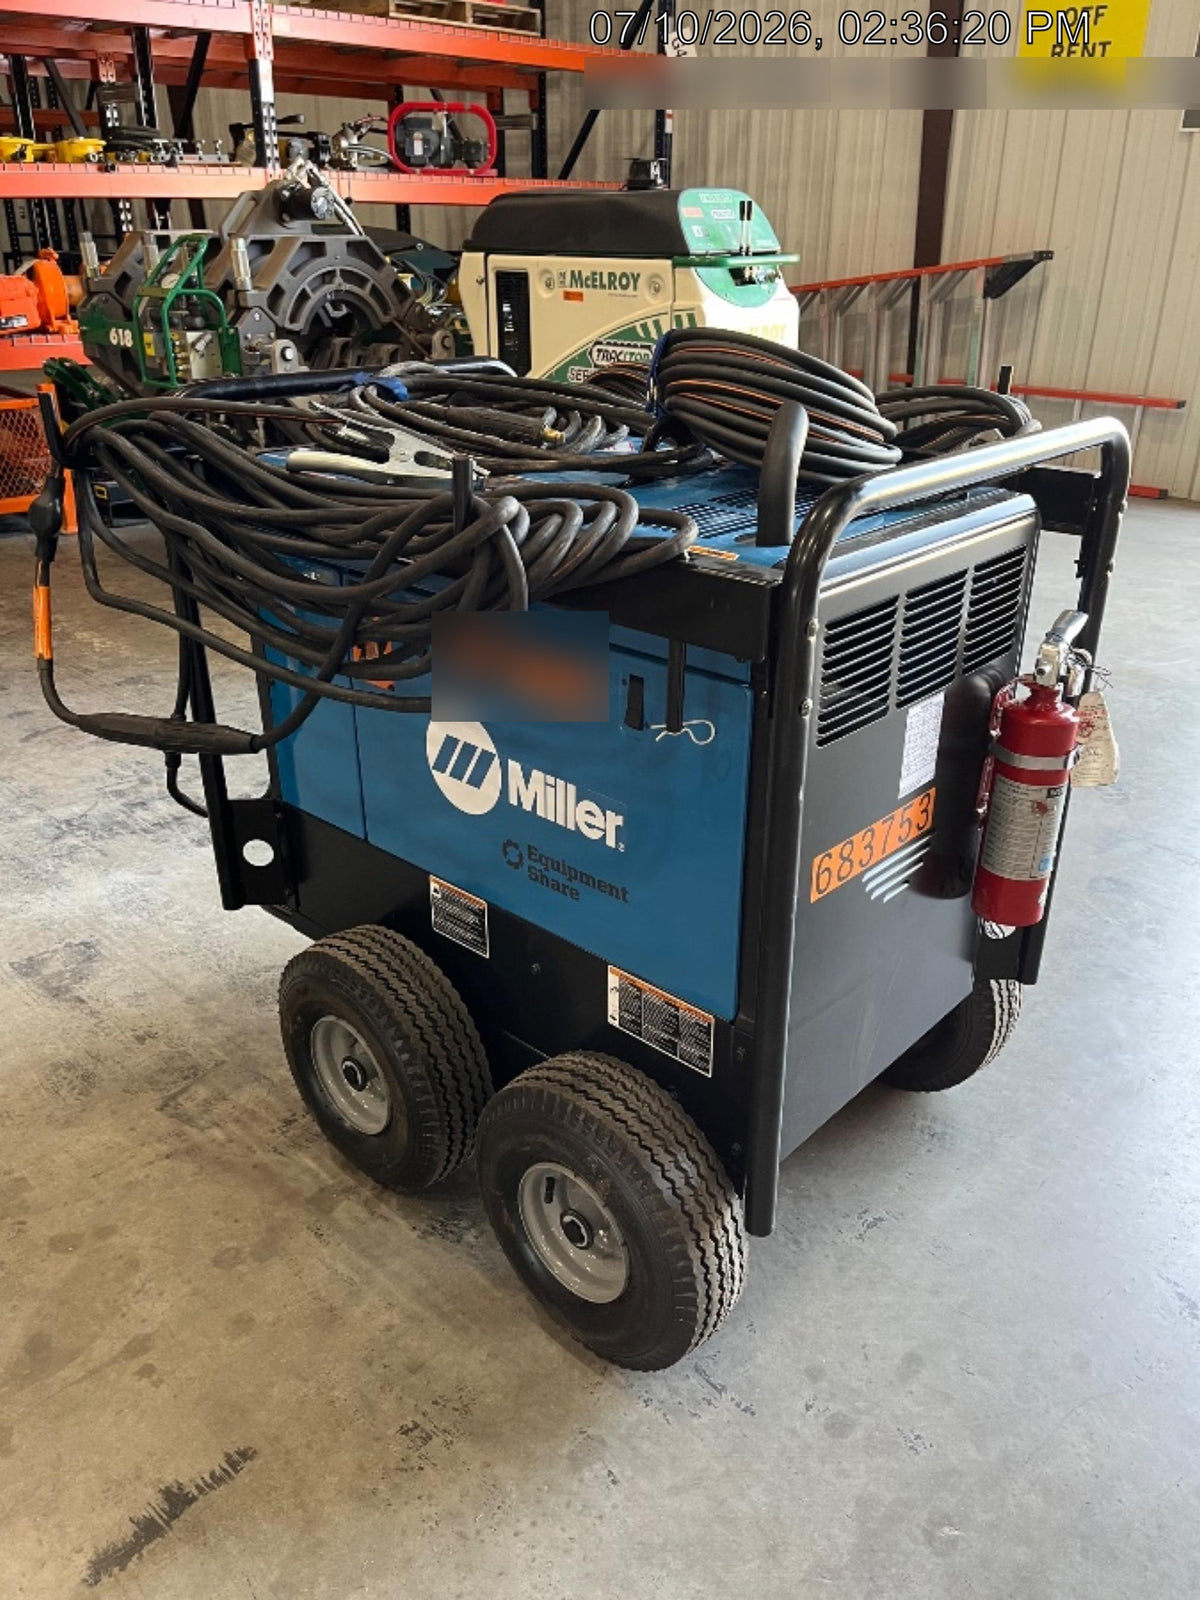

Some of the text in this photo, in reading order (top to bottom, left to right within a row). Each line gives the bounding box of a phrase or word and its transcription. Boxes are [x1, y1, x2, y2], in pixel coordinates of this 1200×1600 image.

[1050, 40, 1112, 57] RENT
[570, 269, 641, 292] McELROY
[109, 327, 133, 347] 618
[508, 758, 624, 849] Miller
[815, 792, 932, 894] 683753
[527, 843, 630, 903] Equipment
[527, 864, 581, 901] Share
